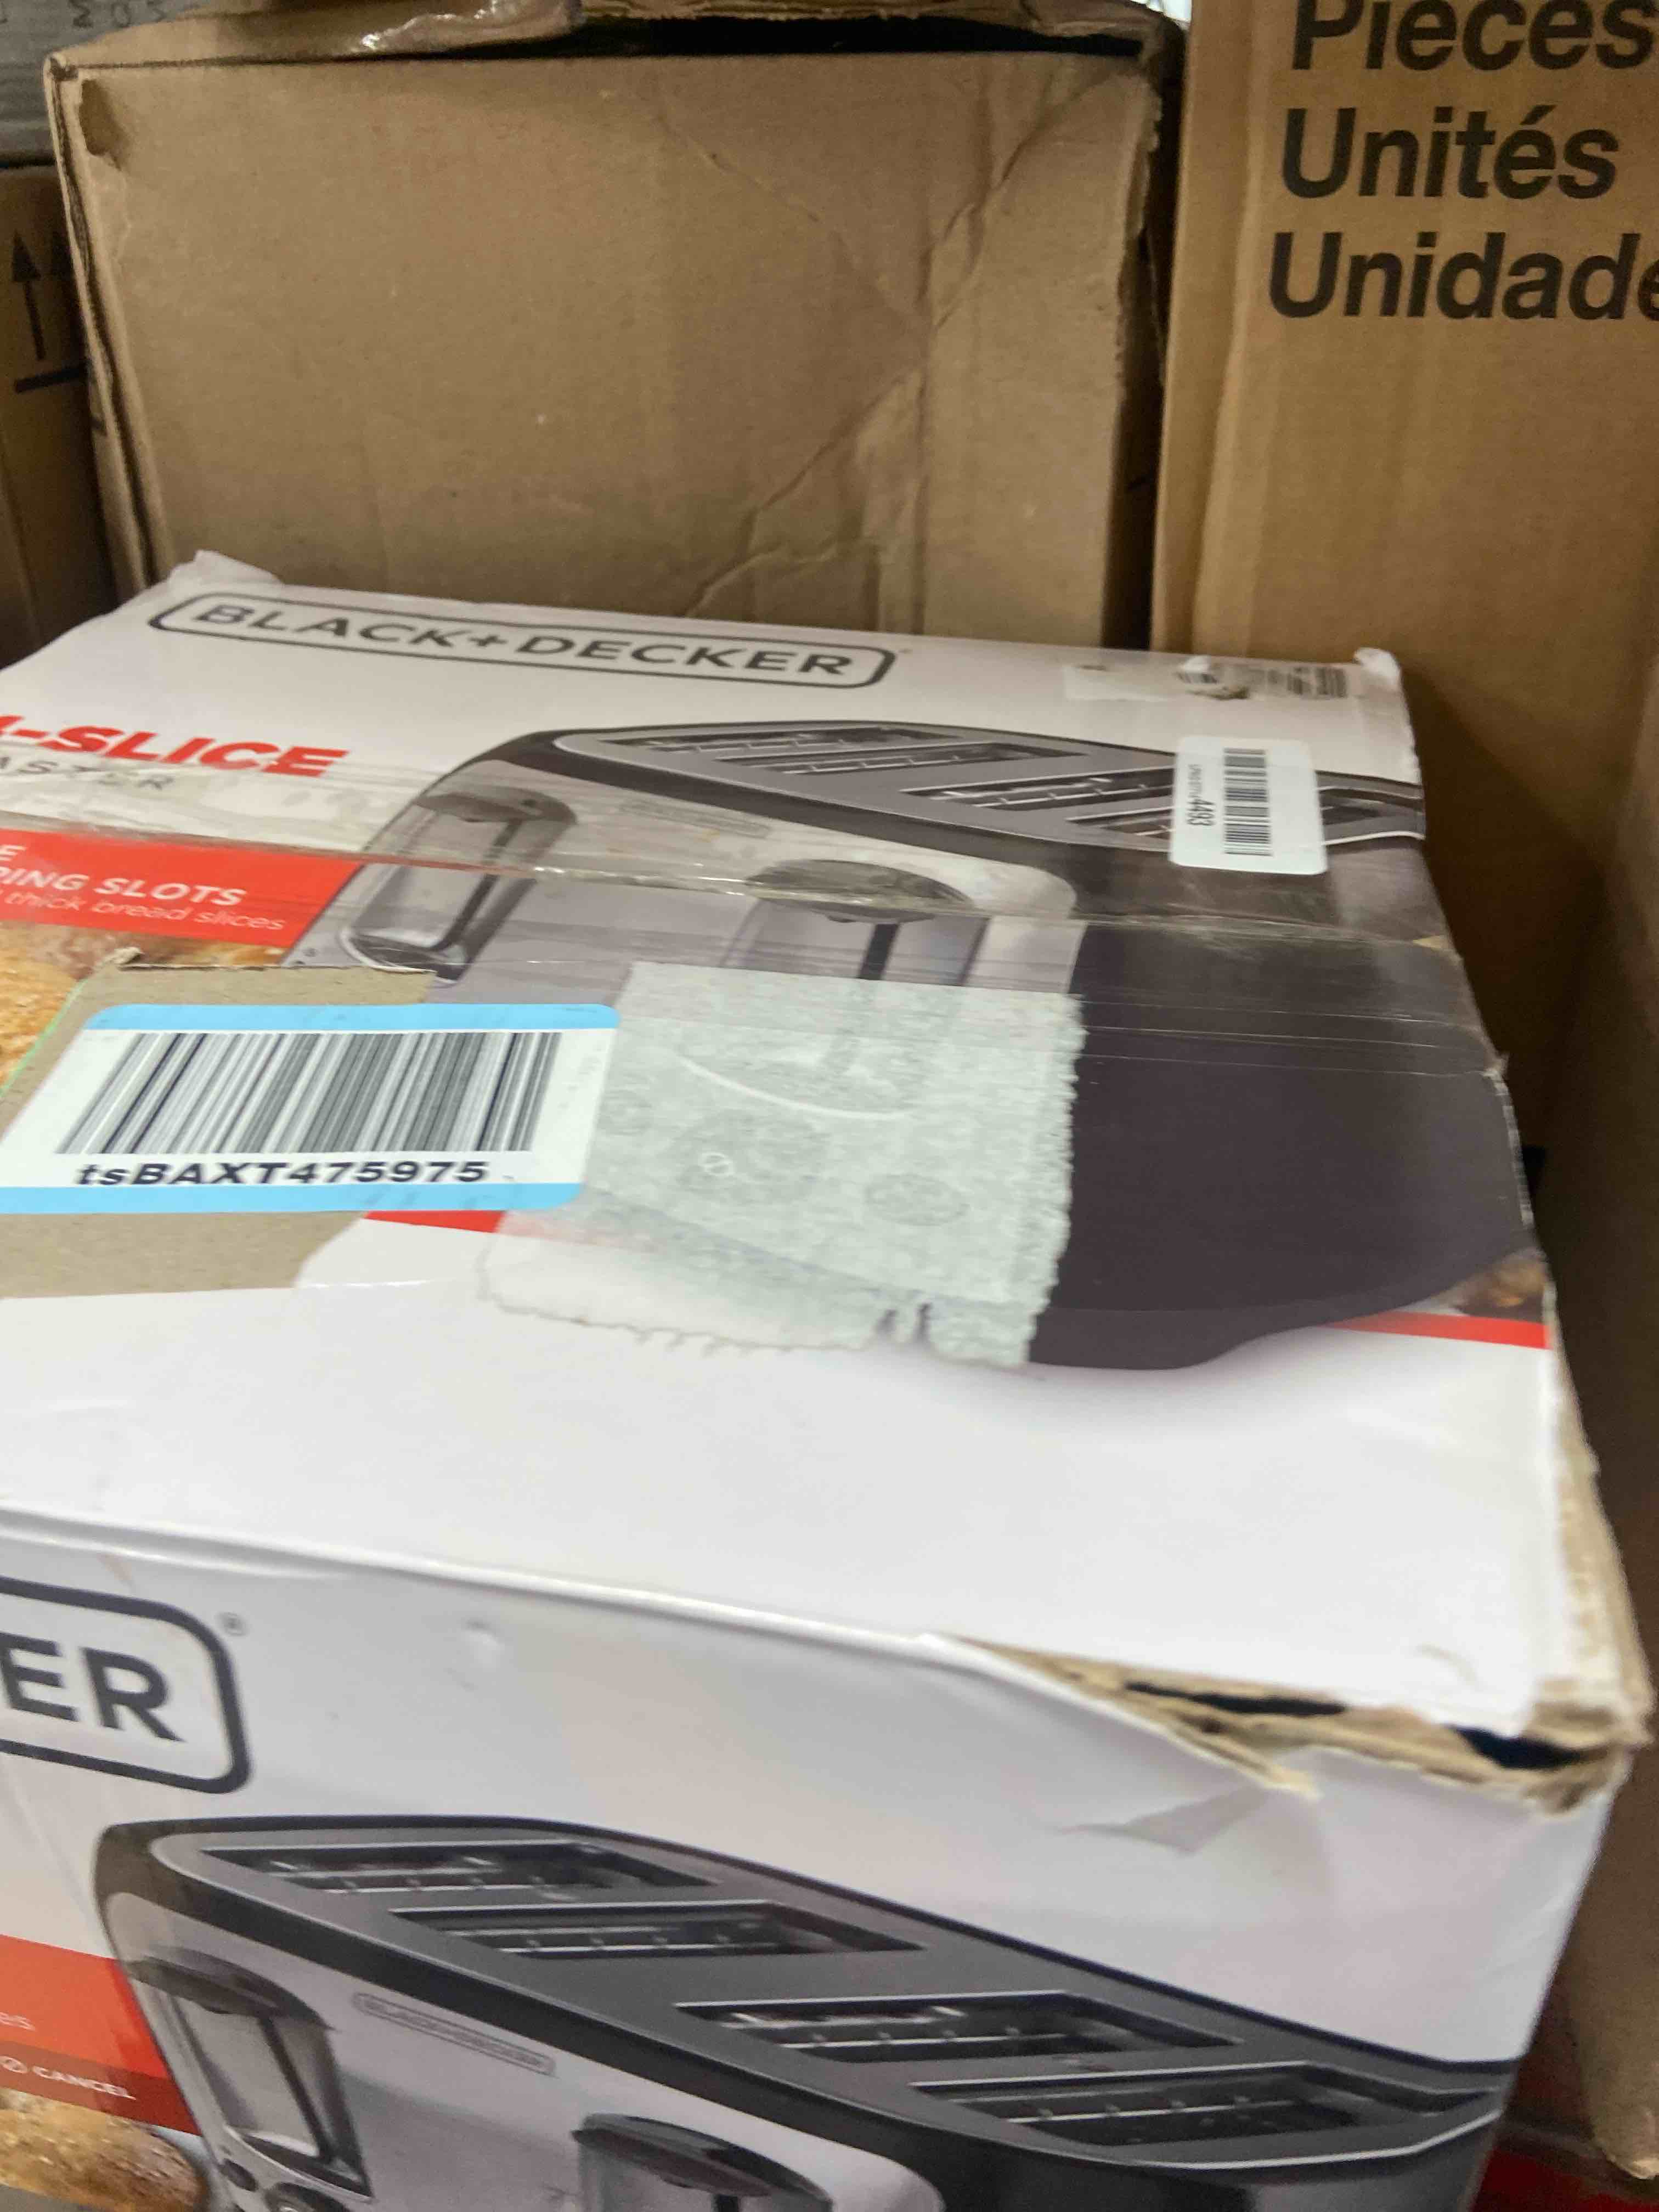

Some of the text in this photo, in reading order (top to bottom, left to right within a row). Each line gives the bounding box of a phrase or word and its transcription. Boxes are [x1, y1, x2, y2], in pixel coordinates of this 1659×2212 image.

[1282, 104, 1620, 200] Unités
[192, 604, 853, 676] BLACK+DECKER
[90, 899, 194, 921] bread
[194, 910, 286, 930] slices
[92, 877, 247, 906] SLOTS
[75, 1160, 490, 1186] tsBAXT475975
[0, 1632, 187, 1743] ER
